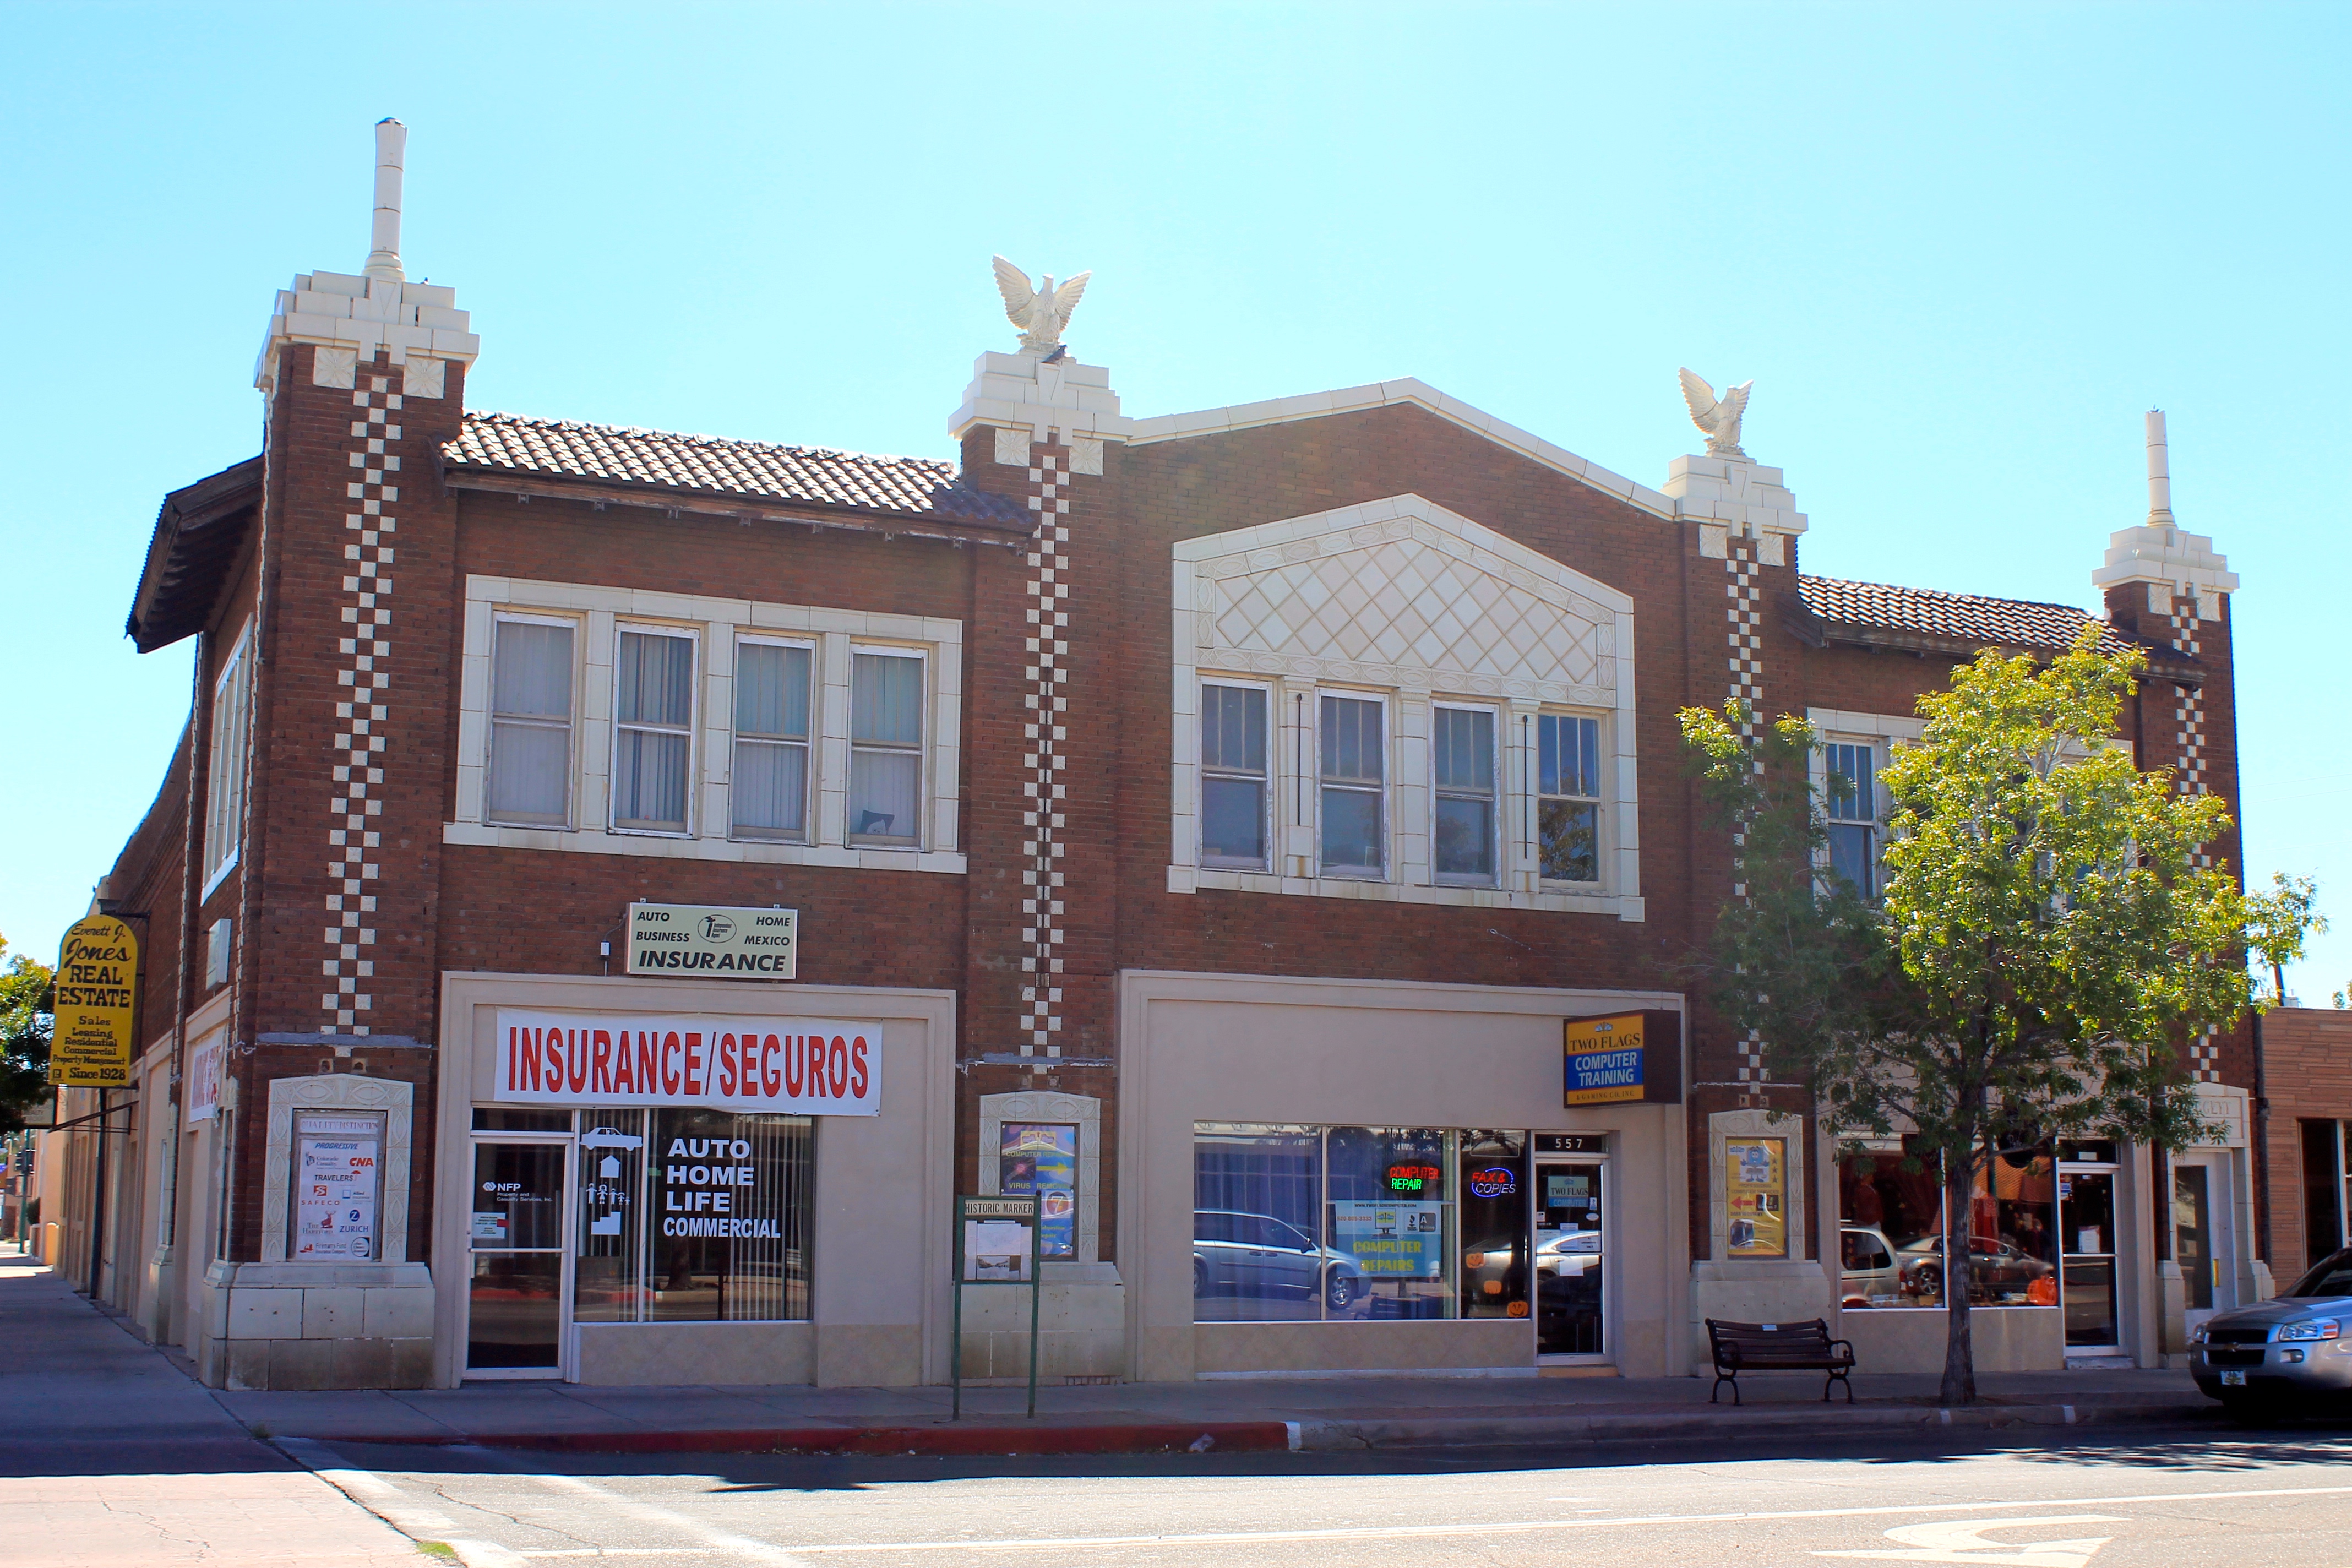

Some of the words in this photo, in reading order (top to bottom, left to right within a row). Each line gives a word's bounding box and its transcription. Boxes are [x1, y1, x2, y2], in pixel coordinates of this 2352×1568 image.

[637, 911, 670, 922] AUTO
[756, 916, 791, 927] HOME
[71, 923, 111, 937] Everett
[113, 924, 126, 943] J.
[636, 931, 690, 942] BUSINESS
[744, 935, 790, 946] MEXICO
[64, 938, 131, 968] Jones
[639, 950, 786, 971] INSURANCE
[69, 965, 123, 985] REAL
[58, 987, 131, 1008] ESTATE
[79, 1015, 111, 1026] Sales
[72, 1027, 113, 1039] Leasing
[64, 1037, 117, 1047] Residential
[1570, 1038, 1597, 1052] TWO
[1601, 1033, 1640, 1048] FLAGS
[63, 1046, 117, 1055] Commercial
[52, 1054, 83, 1065] Property
[83, 1055, 126, 1066] Management
[508, 1026, 868, 1099] INSURANCE/SEGUROS
[1575, 1052, 1637, 1071] COMPUTER
[69, 1067, 99, 1079] Since
[100, 1068, 126, 1080] 1928
[1578, 1068, 1634, 1087] TRAINING
[667, 1138, 750, 1159] AUTO
[1555, 1138, 1582, 1148] 557
[349, 1157, 374, 1167] CNA
[667, 1165, 754, 1186] HOME
[1390, 1166, 1439, 1180] COMPUTER
[1472, 1172, 1496, 1182] FAX
[1498, 1173, 1506, 1183] &
[497, 1183, 521, 1191] NFP
[1391, 1178, 1422, 1190] REPAIR
[1476, 1183, 1516, 1194] COPIES
[666, 1191, 731, 1212] LIFE
[965, 1202, 1000, 1213] HISTORIC
[1003, 1203, 1033, 1213] MARKER
[663, 1217, 781, 1238] COMMERCIAL
[1353, 1241, 1422, 1253] COMPUTER
[1360, 1259, 1414, 1271] REPAIRS
